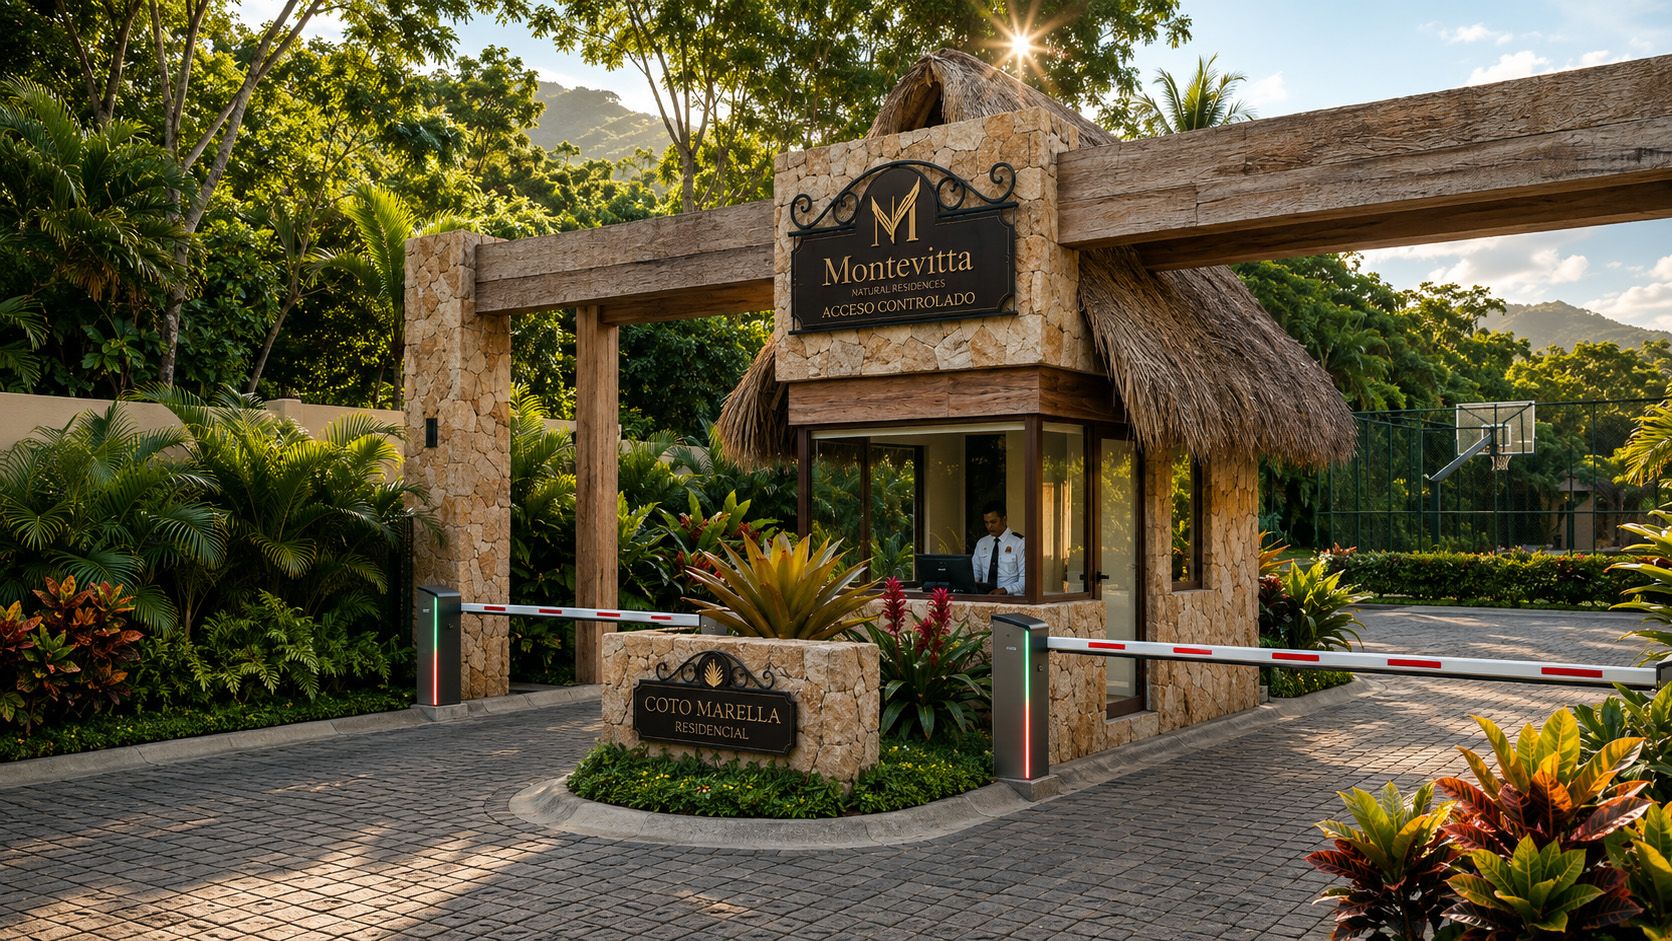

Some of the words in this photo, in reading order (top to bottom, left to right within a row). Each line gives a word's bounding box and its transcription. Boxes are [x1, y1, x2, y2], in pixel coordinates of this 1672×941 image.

[822, 247, 974, 287] Montevitta
[852, 285, 891, 297] NATURAL
[892, 279, 946, 293] RESIDENCES
[822, 302, 875, 319] ACCESO
[877, 291, 976, 314] CONTROLADO
[644, 696, 692, 716] COTO
[696, 700, 782, 724] MARELLA
[675, 720, 750, 740] RESIDENCIAL
